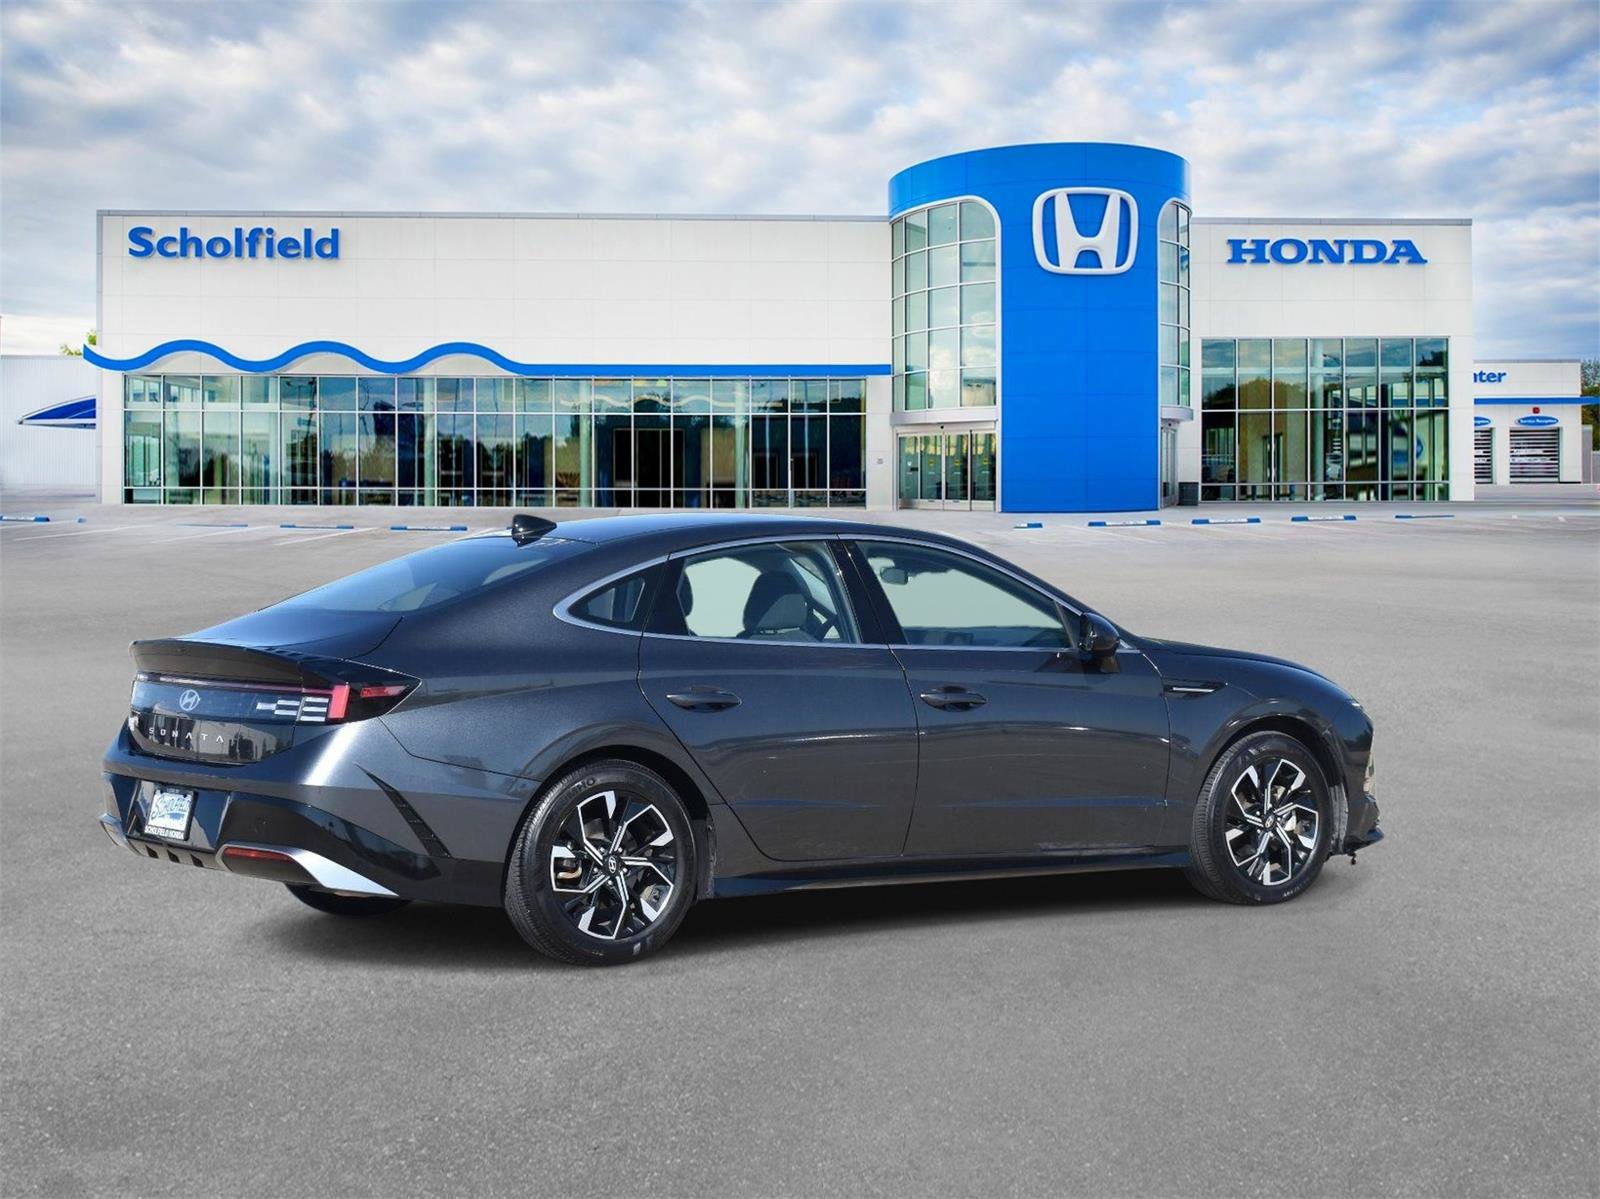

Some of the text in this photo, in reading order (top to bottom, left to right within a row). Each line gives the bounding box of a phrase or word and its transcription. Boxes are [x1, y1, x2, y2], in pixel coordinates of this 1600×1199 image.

[128, 227, 339, 258] Scholfield
[1226, 239, 1428, 264] HONDA
[148, 727, 224, 743] SONATA
